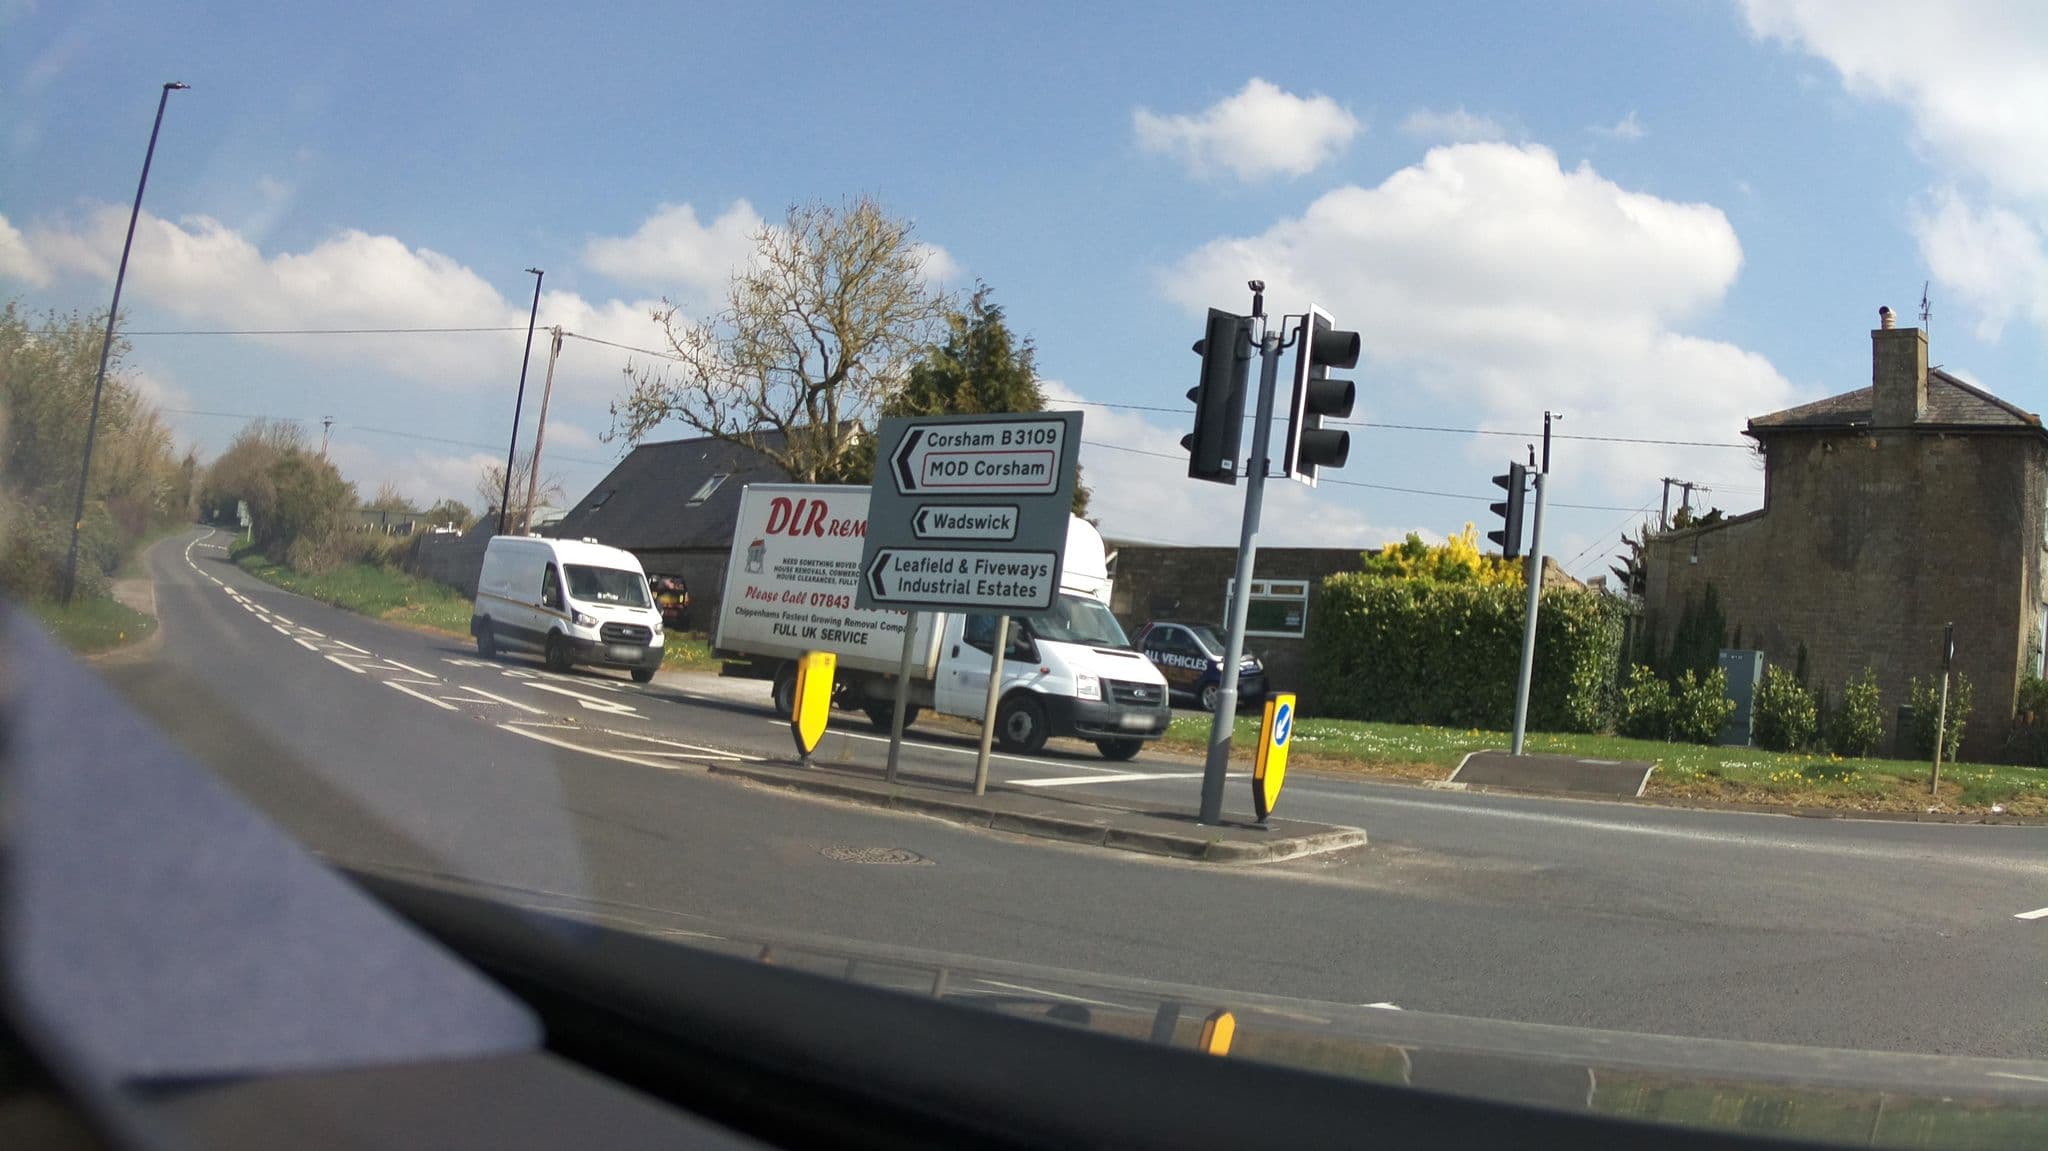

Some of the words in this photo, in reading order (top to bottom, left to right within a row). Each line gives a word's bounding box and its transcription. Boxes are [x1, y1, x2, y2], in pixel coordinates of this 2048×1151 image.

[928, 431, 994, 447] Corsham
[930, 461, 969, 477] MOD
[974, 460, 1045, 476] Corsham
[765, 497, 829, 538] DLR
[933, 514, 1011, 530] Wadswick
[773, 565, 793, 573] HOUSE
[799, 558, 834, 568] SOMETHING
[835, 560, 857, 569] MOVED
[895, 557, 953, 574] Leafield
[959, 559, 969, 574] &
[975, 559, 1048, 582] Fiveways
[776, 573, 796, 581] HOUSE
[838, 577, 857, 587] FULLY
[898, 577, 970, 595] Industrial
[977, 582, 1038, 598] Estates
[745, 586, 779, 602] Please
[782, 590, 807, 605] Call
[810, 592, 850, 609] 07843
[735, 606, 780, 620] Chippenhams
[782, 612, 808, 623] Fastest
[811, 614, 842, 628] Growing
[844, 618, 878, 630] Removal
[773, 623, 798, 637] FULL
[801, 626, 817, 639] UK
[820, 628, 869, 645] SERVICE
[1162, 651, 1209, 671] VEHICLES
